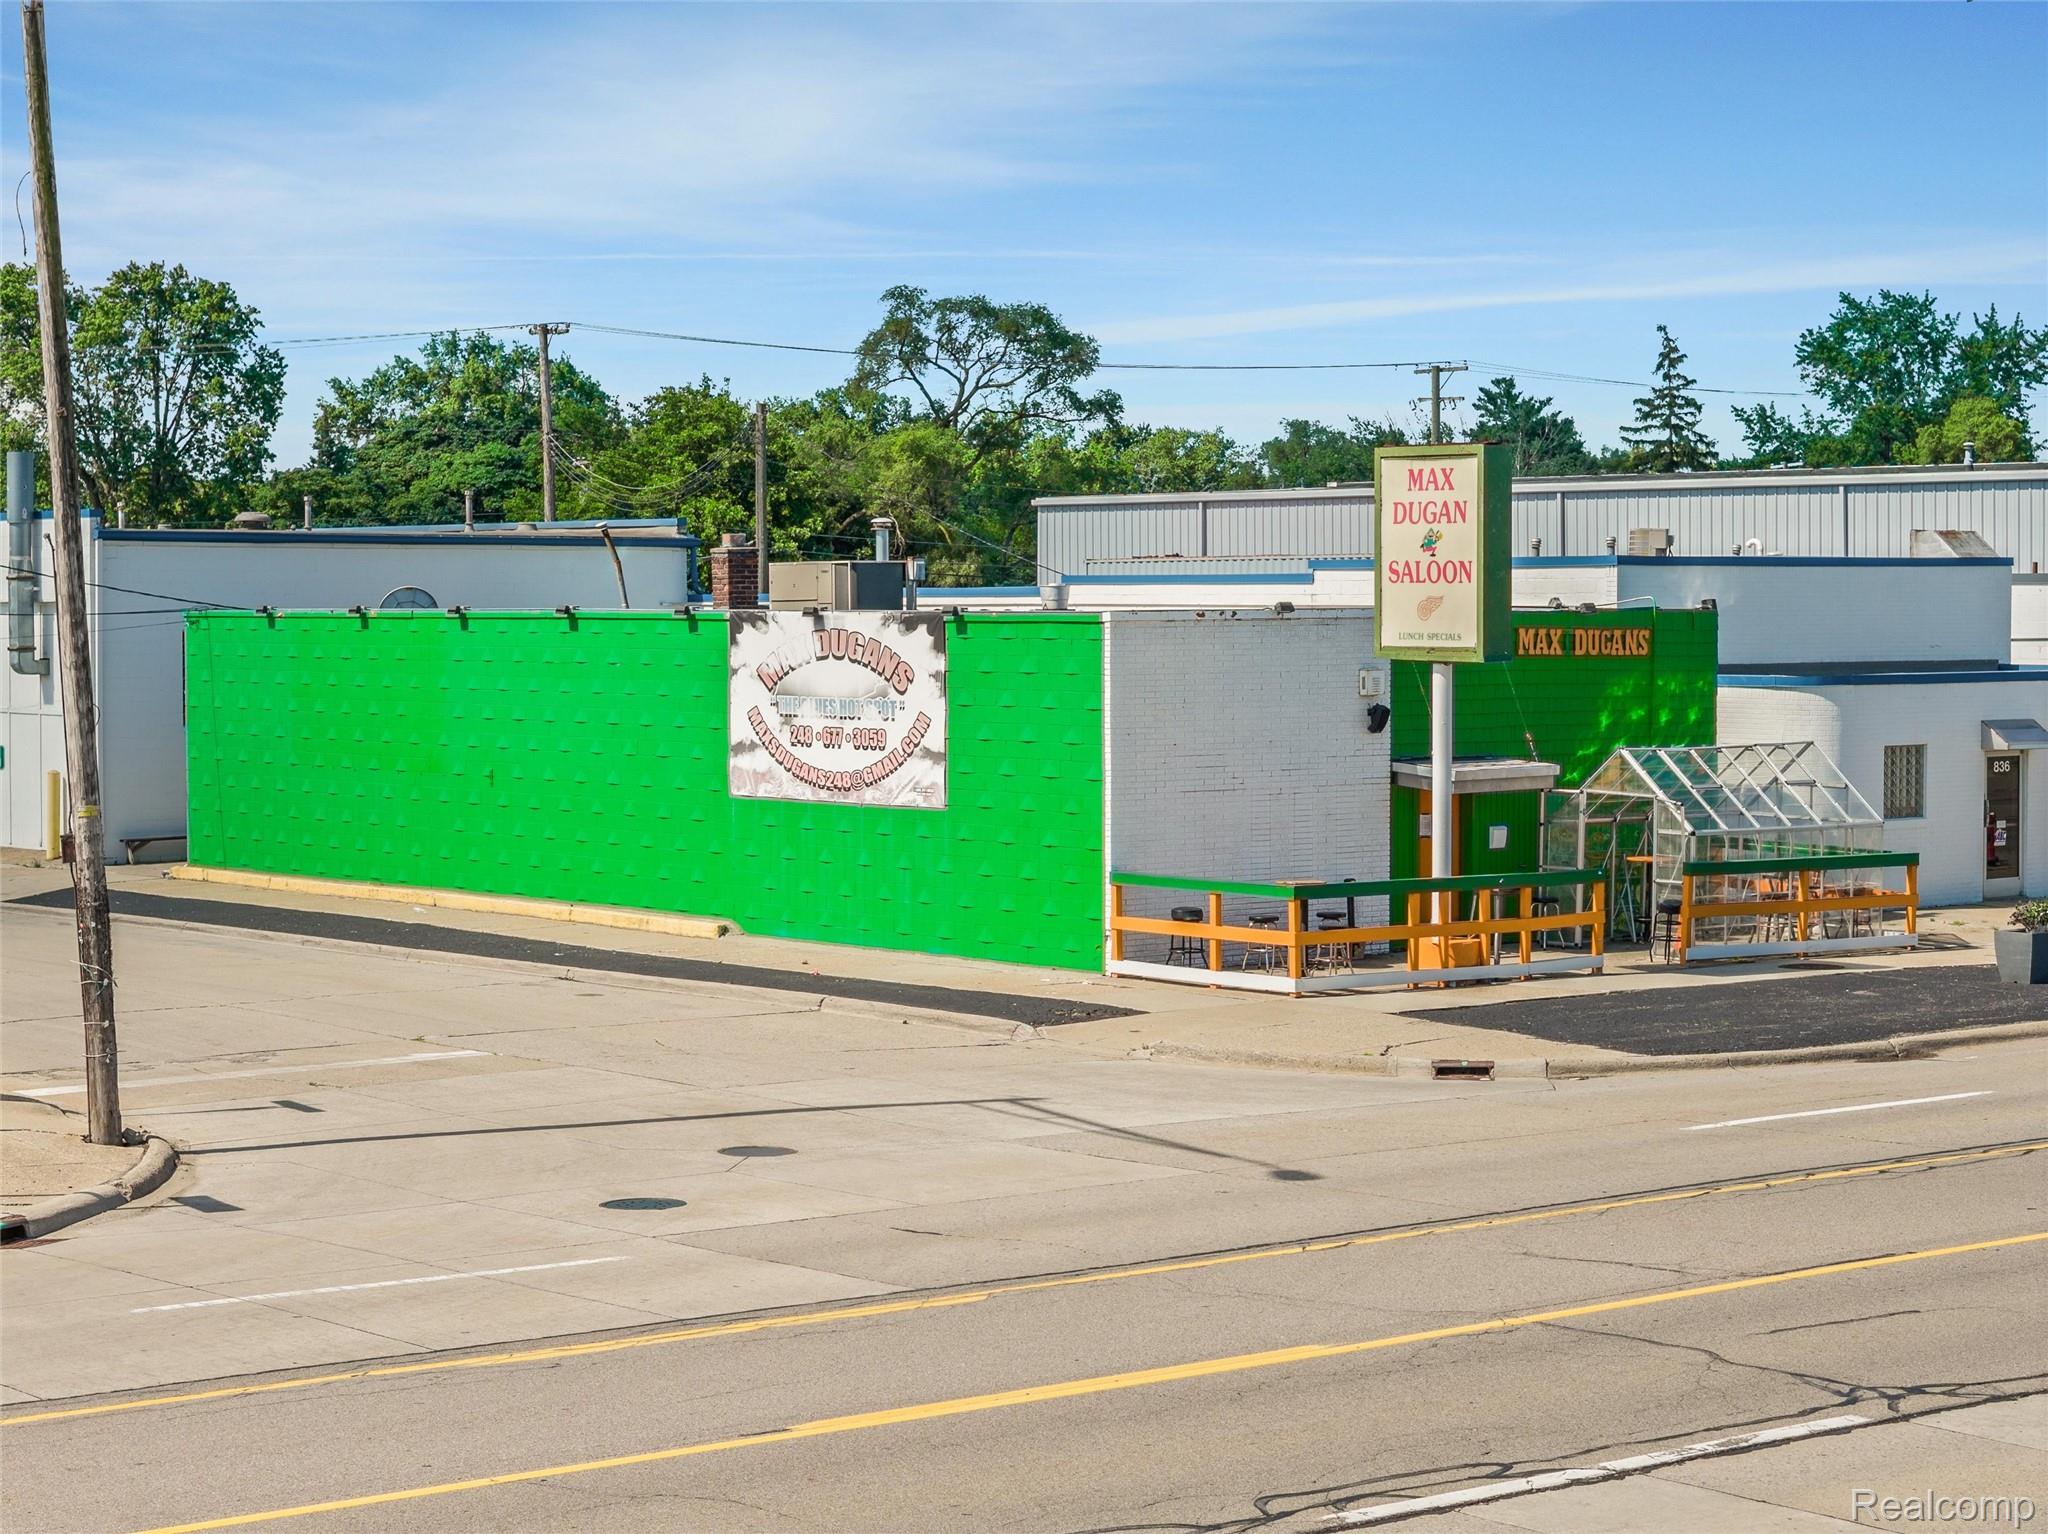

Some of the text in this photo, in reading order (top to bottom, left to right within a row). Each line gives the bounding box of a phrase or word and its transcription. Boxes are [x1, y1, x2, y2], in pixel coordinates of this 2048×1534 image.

[1407, 468, 1455, 491] MAX
[1393, 500, 1467, 525] DUGAN
[1388, 560, 1473, 584] SALOON
[1398, 632, 1462, 641] LUNCH SPECIALS
[1518, 628, 1650, 656] MAX DUGANS
[811, 628, 915, 695] DUGANS
[790, 725, 887, 751] 248 677 3059
[1993, 760, 2010, 772] 836
